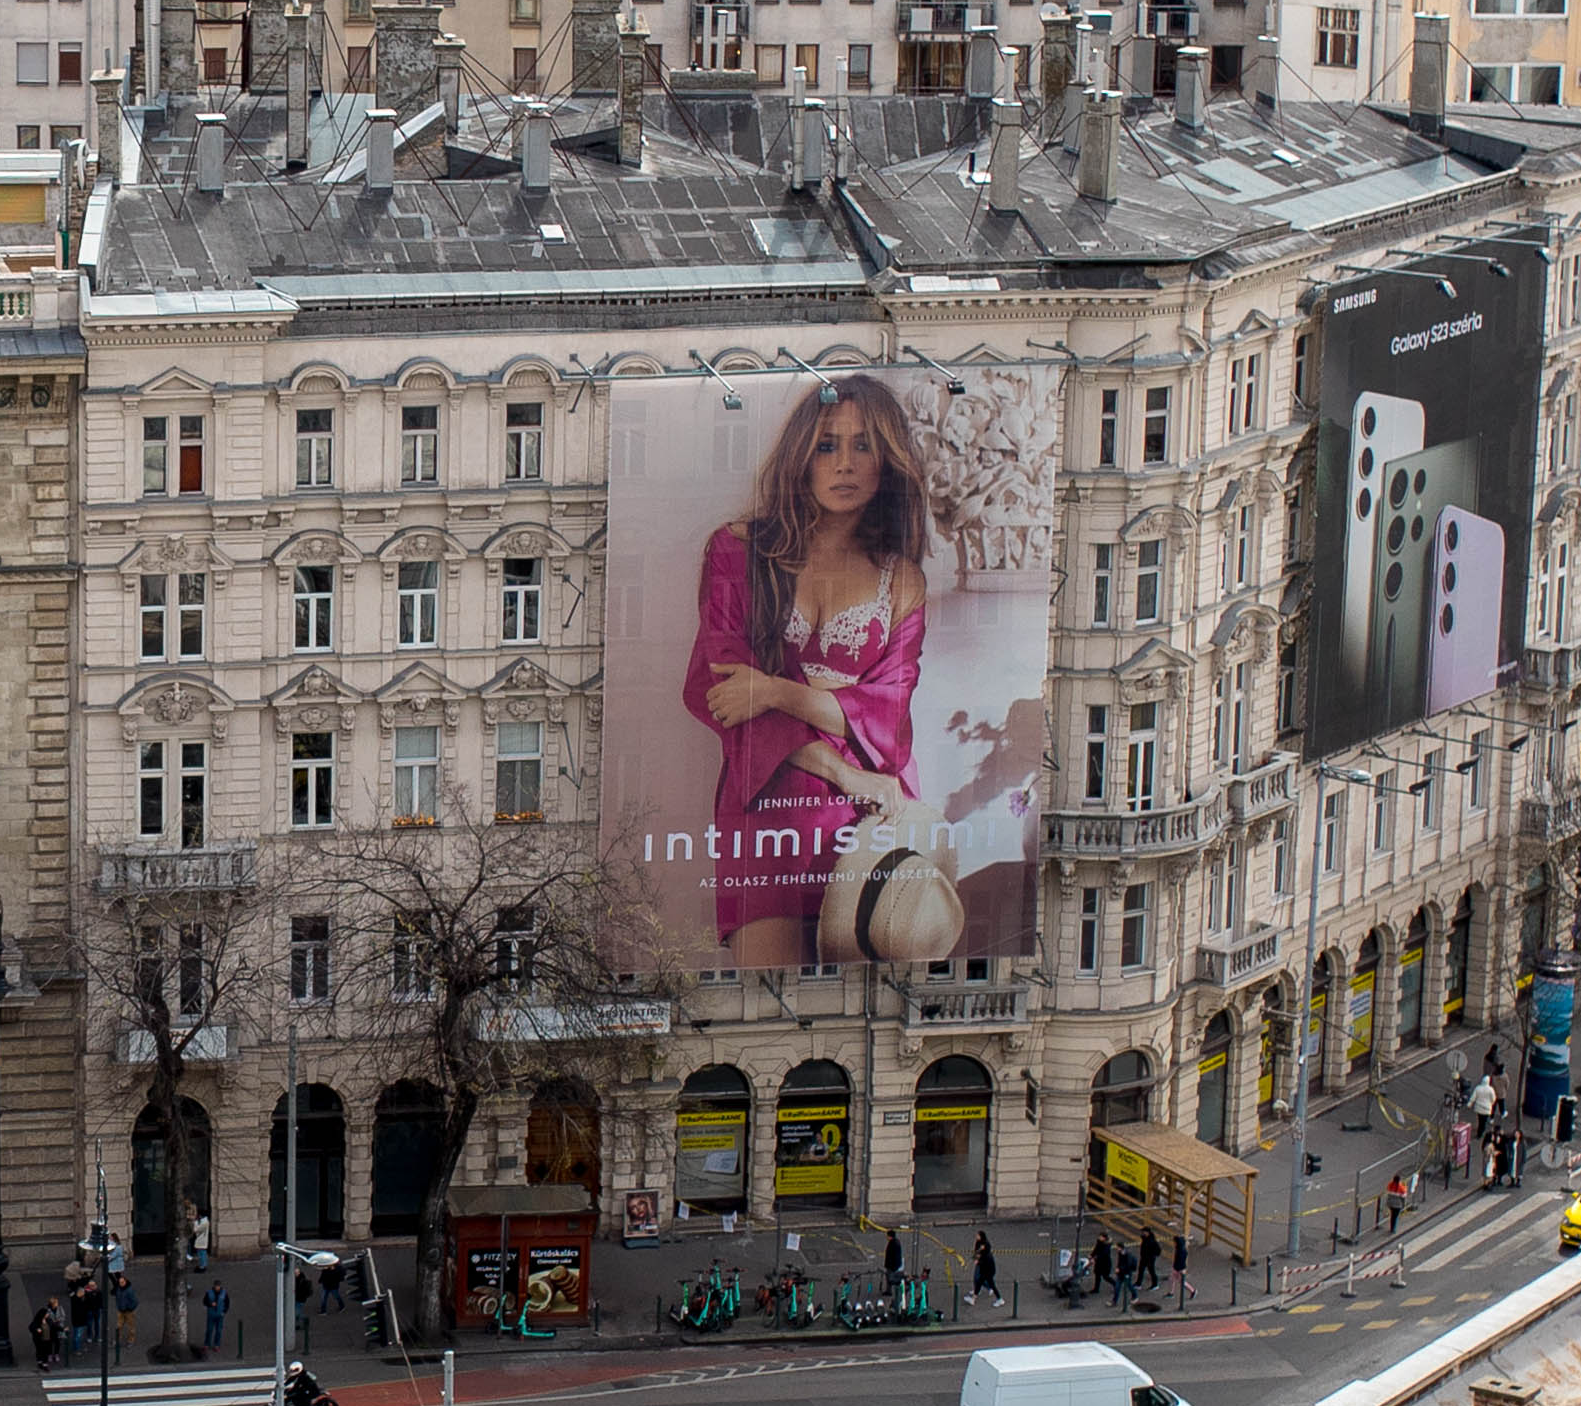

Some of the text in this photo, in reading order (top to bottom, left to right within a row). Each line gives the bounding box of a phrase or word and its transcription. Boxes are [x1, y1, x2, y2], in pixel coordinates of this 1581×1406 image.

[1333, 288, 1378, 314] SAMSUNG
[1391, 310, 1484, 355] Galaxy S23 széria
[758, 796, 821, 811] JENNIFER
[828, 793, 871, 807] LOPEZ
[699, 877, 718, 888] AZ
[724, 875, 768, 887] OLASZ
[774, 869, 856, 885] FEHÉRNEMŰ
[483, 1253, 517, 1261] FITZY
[531, 1249, 578, 1258] Kürtőskalács
